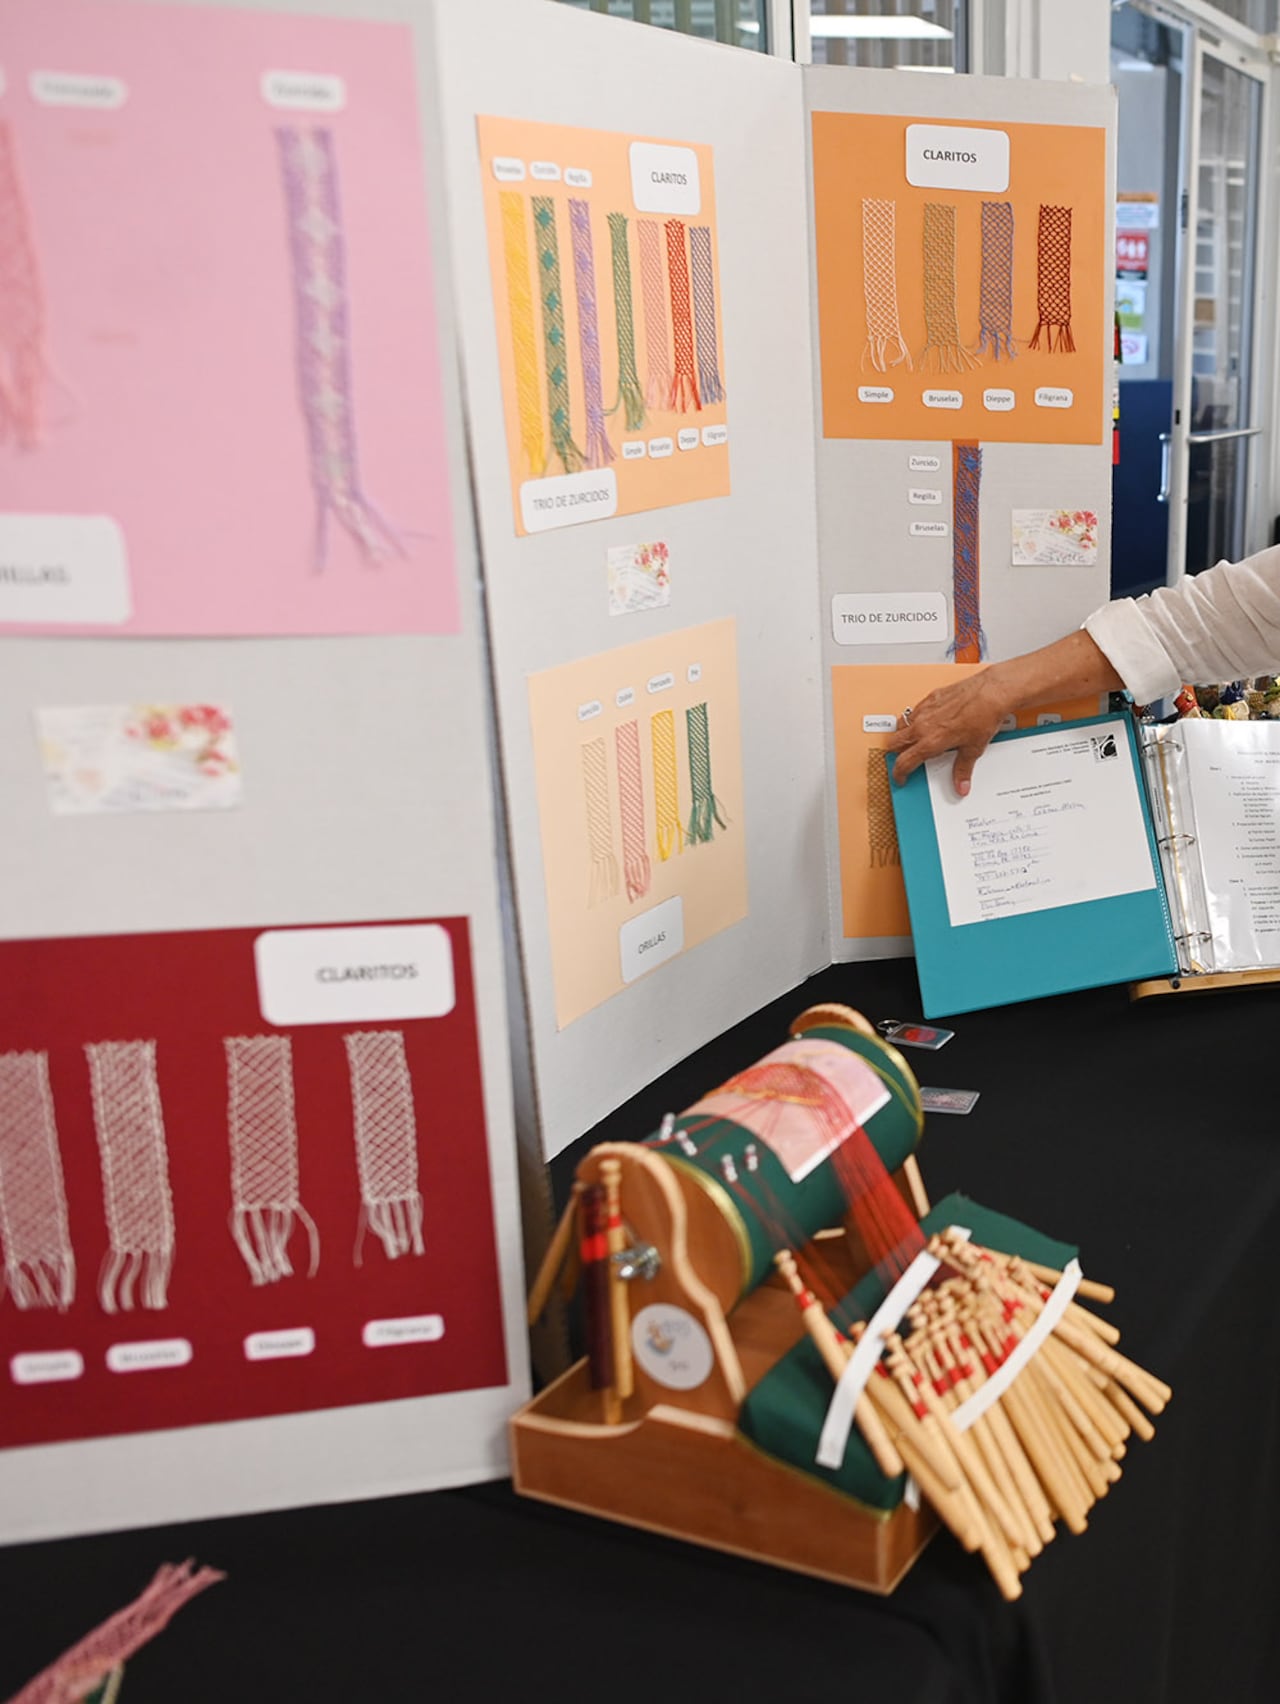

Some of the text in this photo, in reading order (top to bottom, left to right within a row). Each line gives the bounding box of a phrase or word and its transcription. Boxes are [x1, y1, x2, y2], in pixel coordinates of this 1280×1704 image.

[922, 149, 977, 163] CLARITOS
[651, 171, 688, 186] CLARITOS
[864, 390, 889, 400] Simple
[928, 394, 959, 404] Bruselas
[985, 394, 1011, 405] Dieppe
[1038, 392, 1068, 404] Filigrana
[911, 458, 938, 468] Zurcido
[533, 488, 610, 511] TRIO DE ZURCIDOS
[913, 492, 936, 503] Regilla
[914, 523, 944, 533] Bruselas
[841, 611, 938, 624] TRIO DE ZURCIDOS
[865, 719, 892, 729] Sencilla
[637, 931, 667, 955] ORILLAS
[315, 963, 418, 985] CLARITOS
